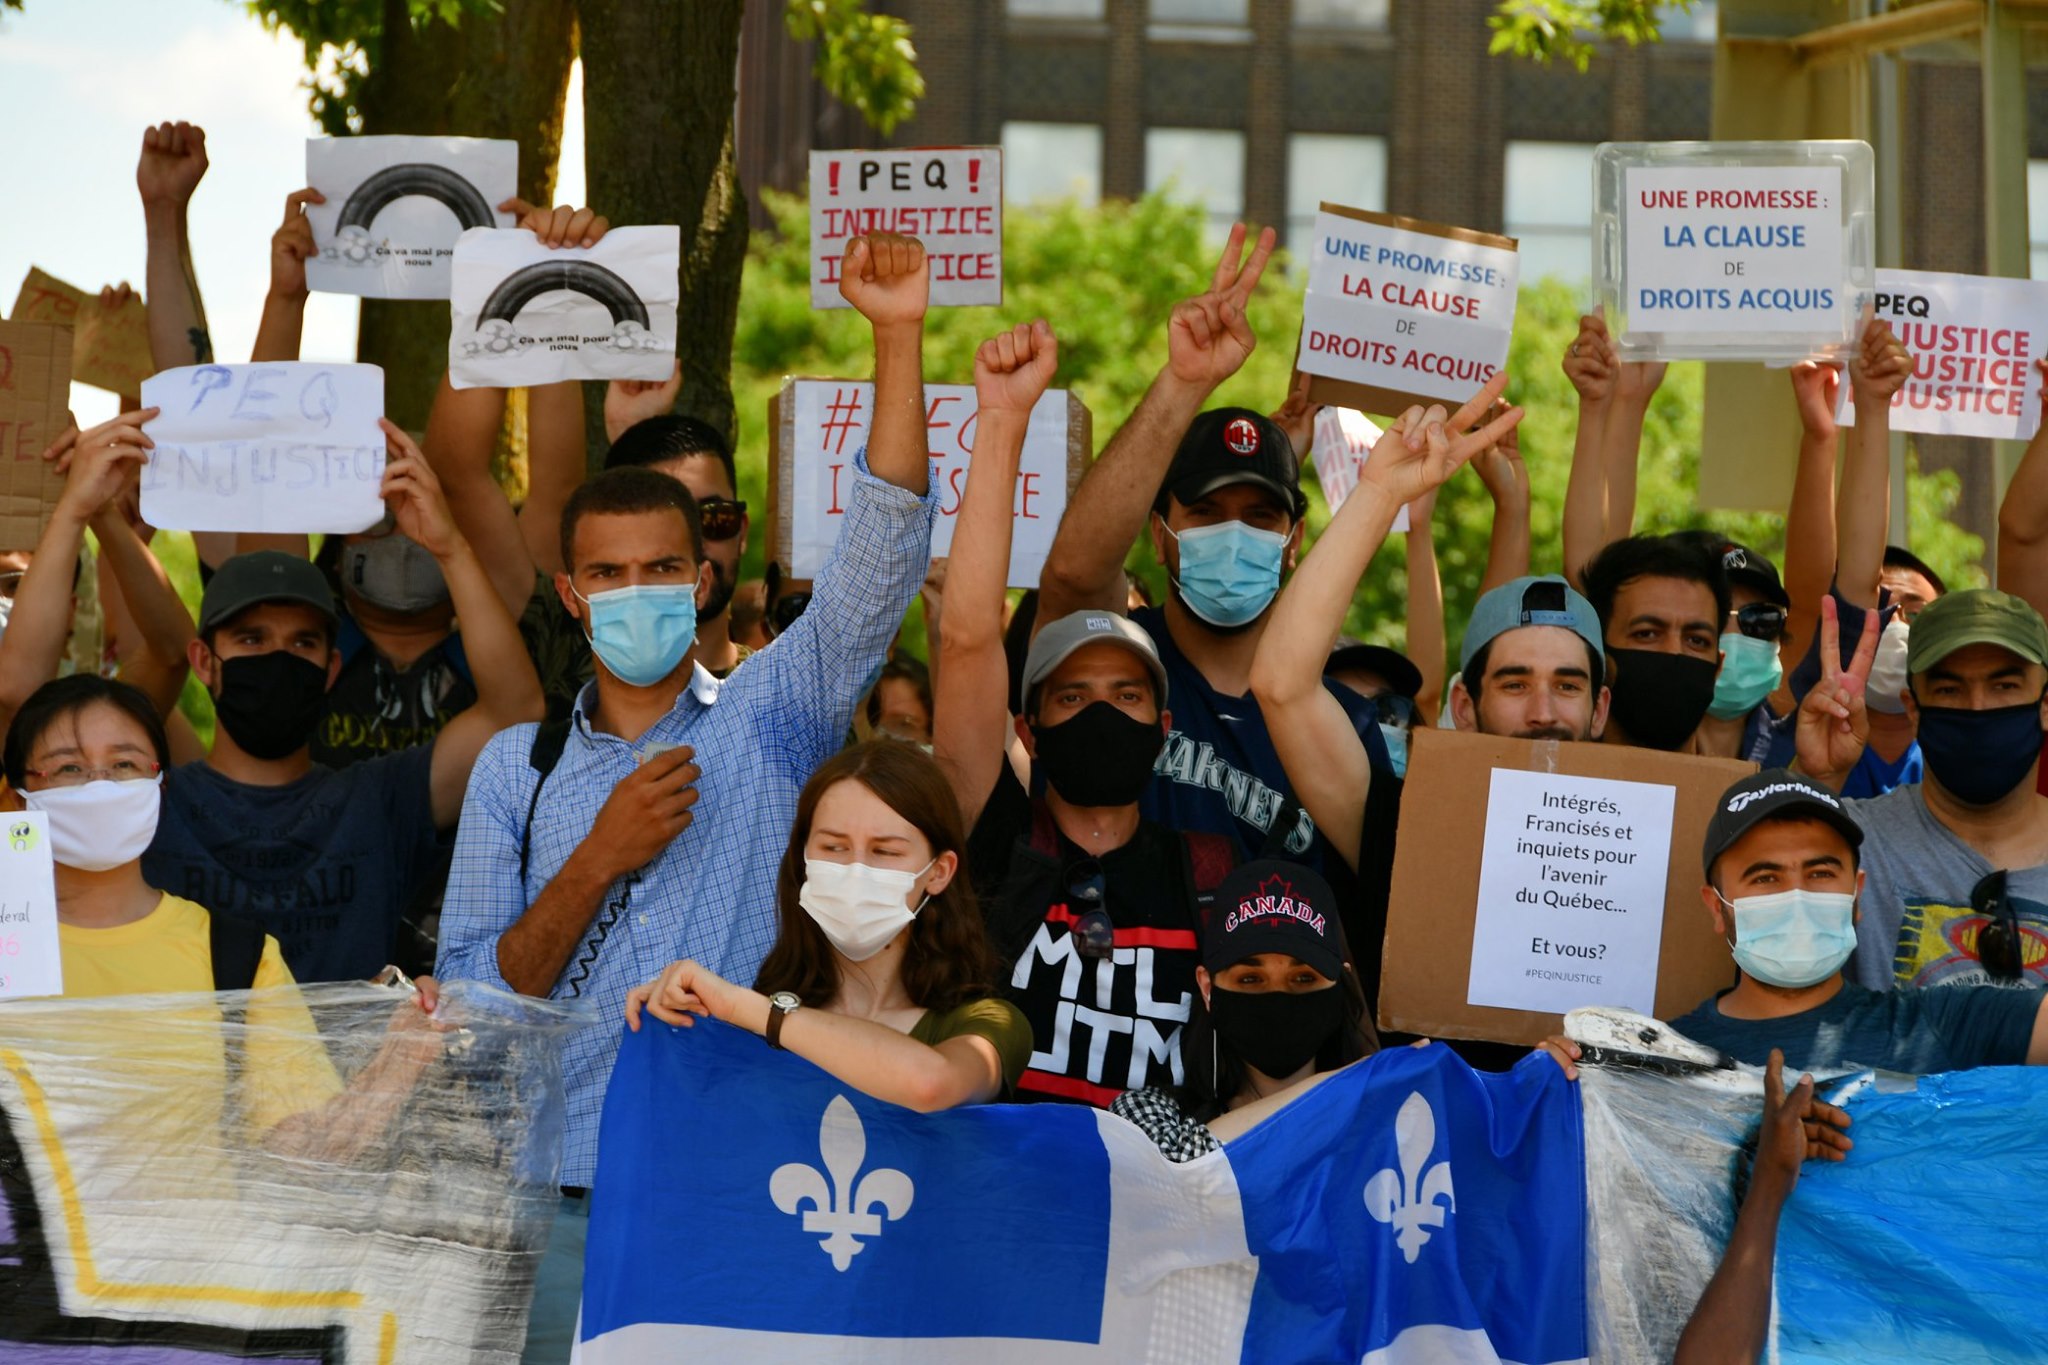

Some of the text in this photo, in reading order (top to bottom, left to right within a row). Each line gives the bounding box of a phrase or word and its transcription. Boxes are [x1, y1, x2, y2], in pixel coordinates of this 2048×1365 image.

[858, 159, 948, 191] PEQ
[1640, 190, 1688, 209] UNE
[1696, 190, 1818, 209] PROMESSE
[821, 207, 993, 239] INJUSTICE
[1664, 225, 1806, 248] LA CLAUSE
[410, 248, 432, 256] mal
[1325, 236, 1372, 262] UNE
[1377, 247, 1497, 287] PROMESSE
[1724, 261, 1745, 276] DE
[1342, 274, 1481, 319] LA CLAUSE
[1640, 289, 1834, 312] DROITS ACQUIS
[557, 334, 579, 342] mal
[583, 336, 611, 344] pour
[1395, 319, 1417, 335] DE
[549, 343, 578, 351] nous
[1308, 330, 1496, 384] DROITS ACQUIS
[188, 365, 350, 429] PEQ
[1542, 791, 1621, 816] Intégrés,
[1727, 782, 1840, 813] TaylorMade
[1525, 814, 1634, 841] Francisés et
[1516, 838, 1637, 865] inquiets pour
[1515, 887, 1538, 905] du
[1225, 895, 1326, 938] CANADA
[1531, 937, 1607, 960] Et vous?
[1010, 921, 1193, 1024] MTL
[1525, 968, 1603, 985] #PEQINJUSTICE
